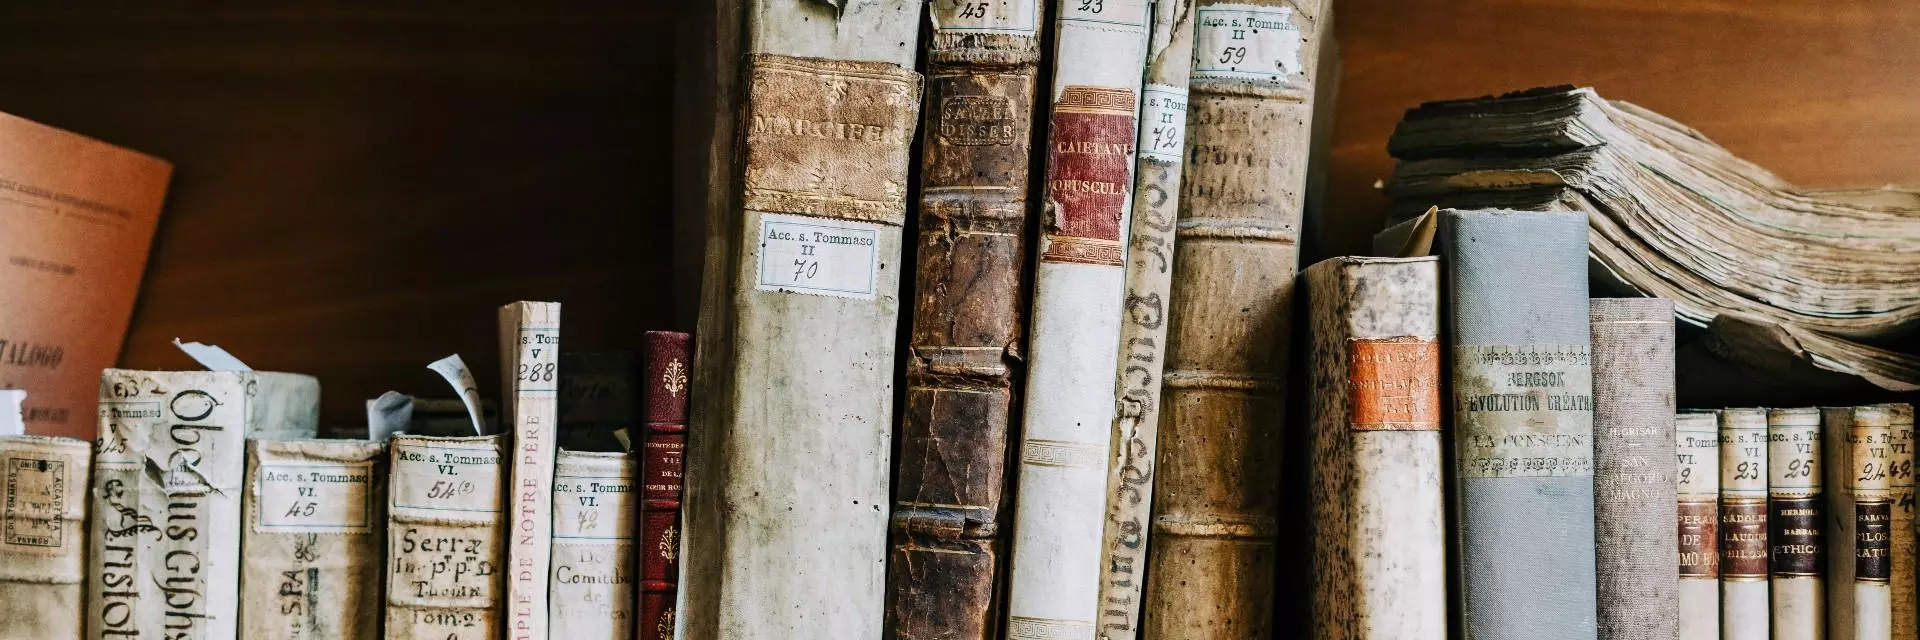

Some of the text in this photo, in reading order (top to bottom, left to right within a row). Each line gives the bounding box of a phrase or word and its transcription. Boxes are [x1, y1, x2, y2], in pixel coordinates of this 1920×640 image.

[959, 2, 989, 19] 45
[1220, 46, 1246, 64] 59
[1153, 126, 1178, 150] 72
[768, 228, 873, 247] Acc. s. Tommaso
[801, 244, 816, 256] II
[794, 258, 819, 282] 70
[531, 348, 541, 359] V
[517, 363, 555, 382] 288
[524, 415, 540, 465] PÈRE
[400, 451, 425, 462] Acc.
[429, 455, 439, 463] s.
[438, 464, 458, 476] VI.
[1734, 461, 1759, 481] 23
[1784, 459, 1814, 479] 25
[1858, 462, 1886, 482] 24
[298, 487, 317, 497] VI.
[285, 501, 318, 518] 45
[579, 496, 599, 507] VI.
[520, 478, 538, 546] NOTRE
[1682, 534, 1701, 546] DE
[519, 558, 533, 583] DE
